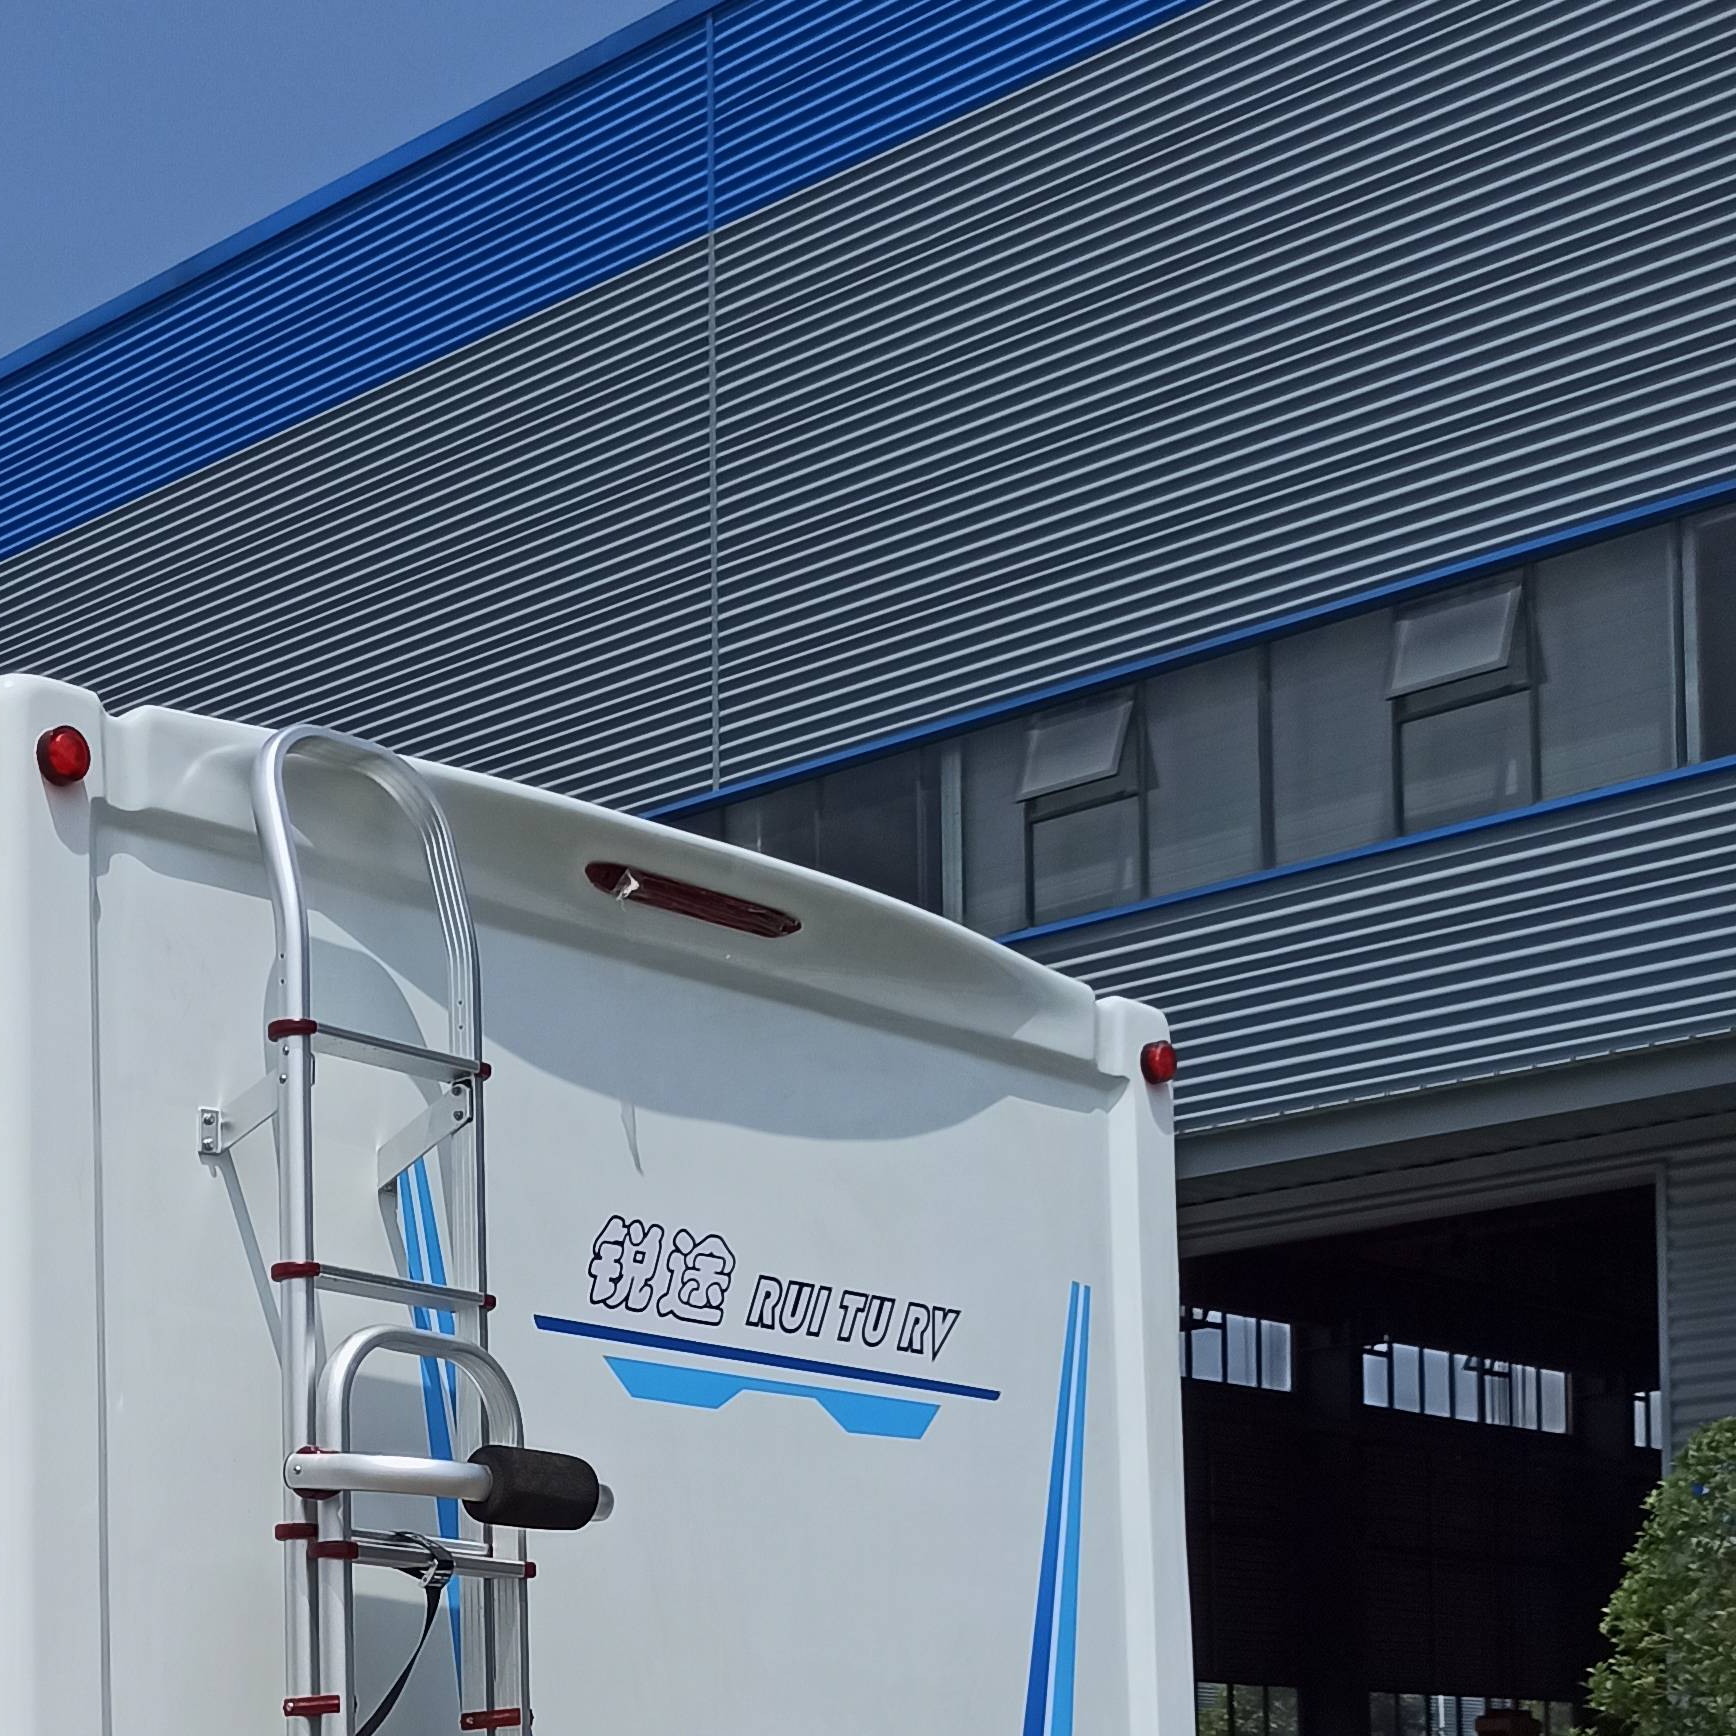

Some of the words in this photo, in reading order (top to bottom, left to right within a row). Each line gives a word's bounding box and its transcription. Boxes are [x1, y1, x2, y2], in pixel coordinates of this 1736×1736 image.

[588, 1215, 736, 1326] 锐途
[746, 1275, 832, 1337] RUI
[837, 1290, 895, 1347] TU
[897, 1303, 962, 1362] RV
